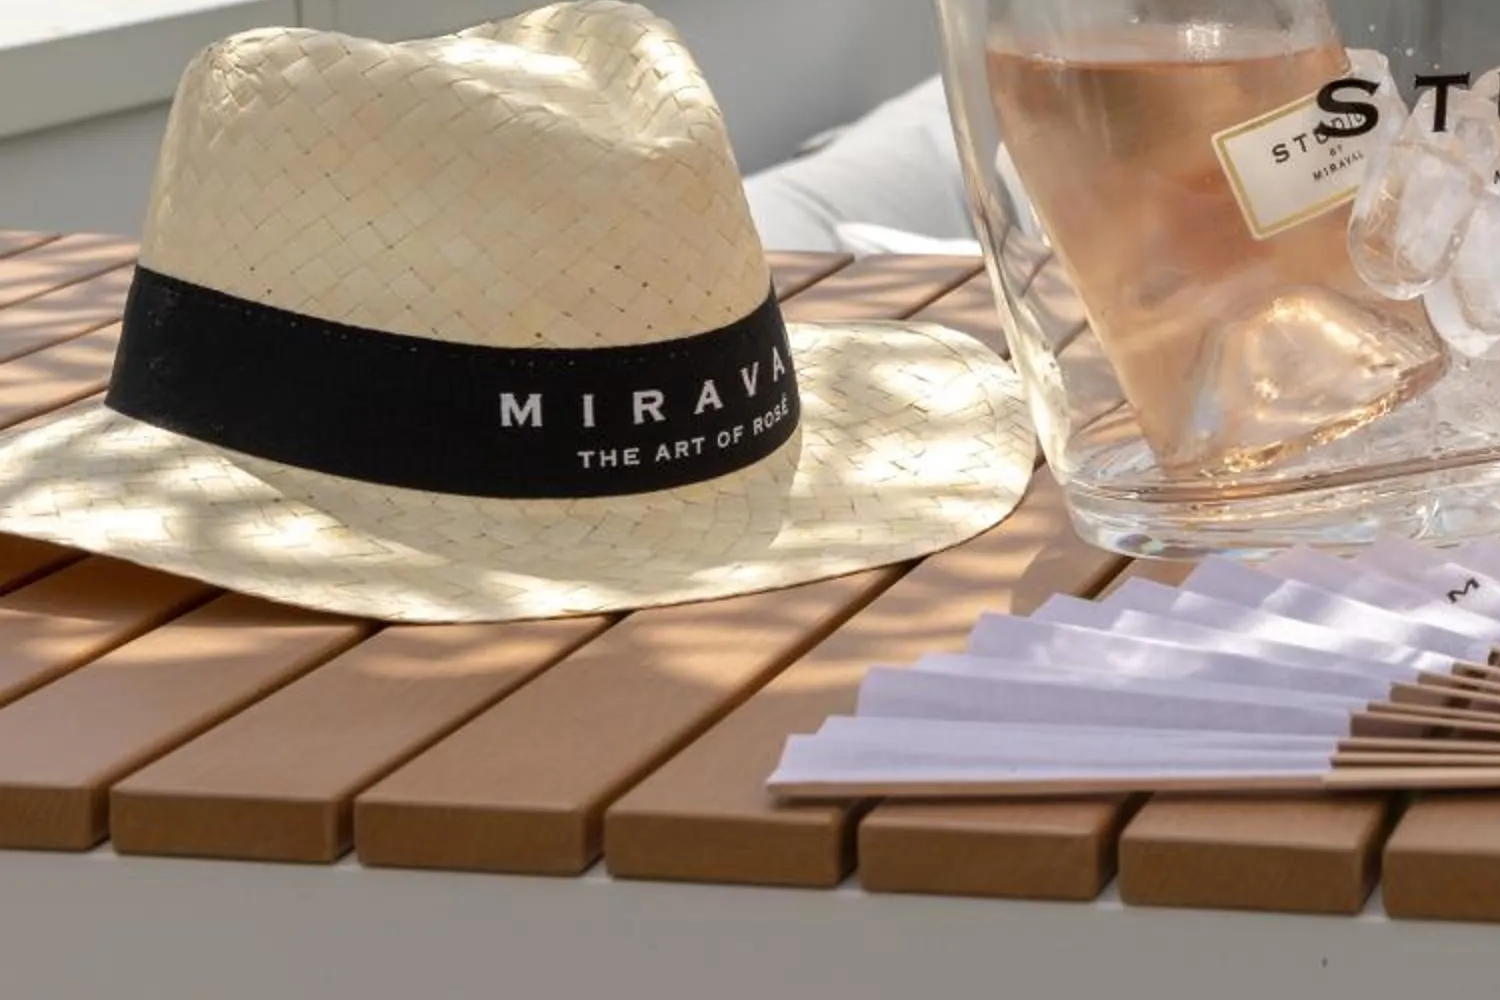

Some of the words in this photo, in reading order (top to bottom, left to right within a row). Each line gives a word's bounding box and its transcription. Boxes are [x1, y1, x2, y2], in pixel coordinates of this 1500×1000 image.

[1313, 150, 1364, 181] MIRAVAL
[500, 345, 791, 428] MIRAVA
[577, 446, 641, 469] THE
[654, 436, 706, 463] ART
[717, 424, 744, 449] OF
